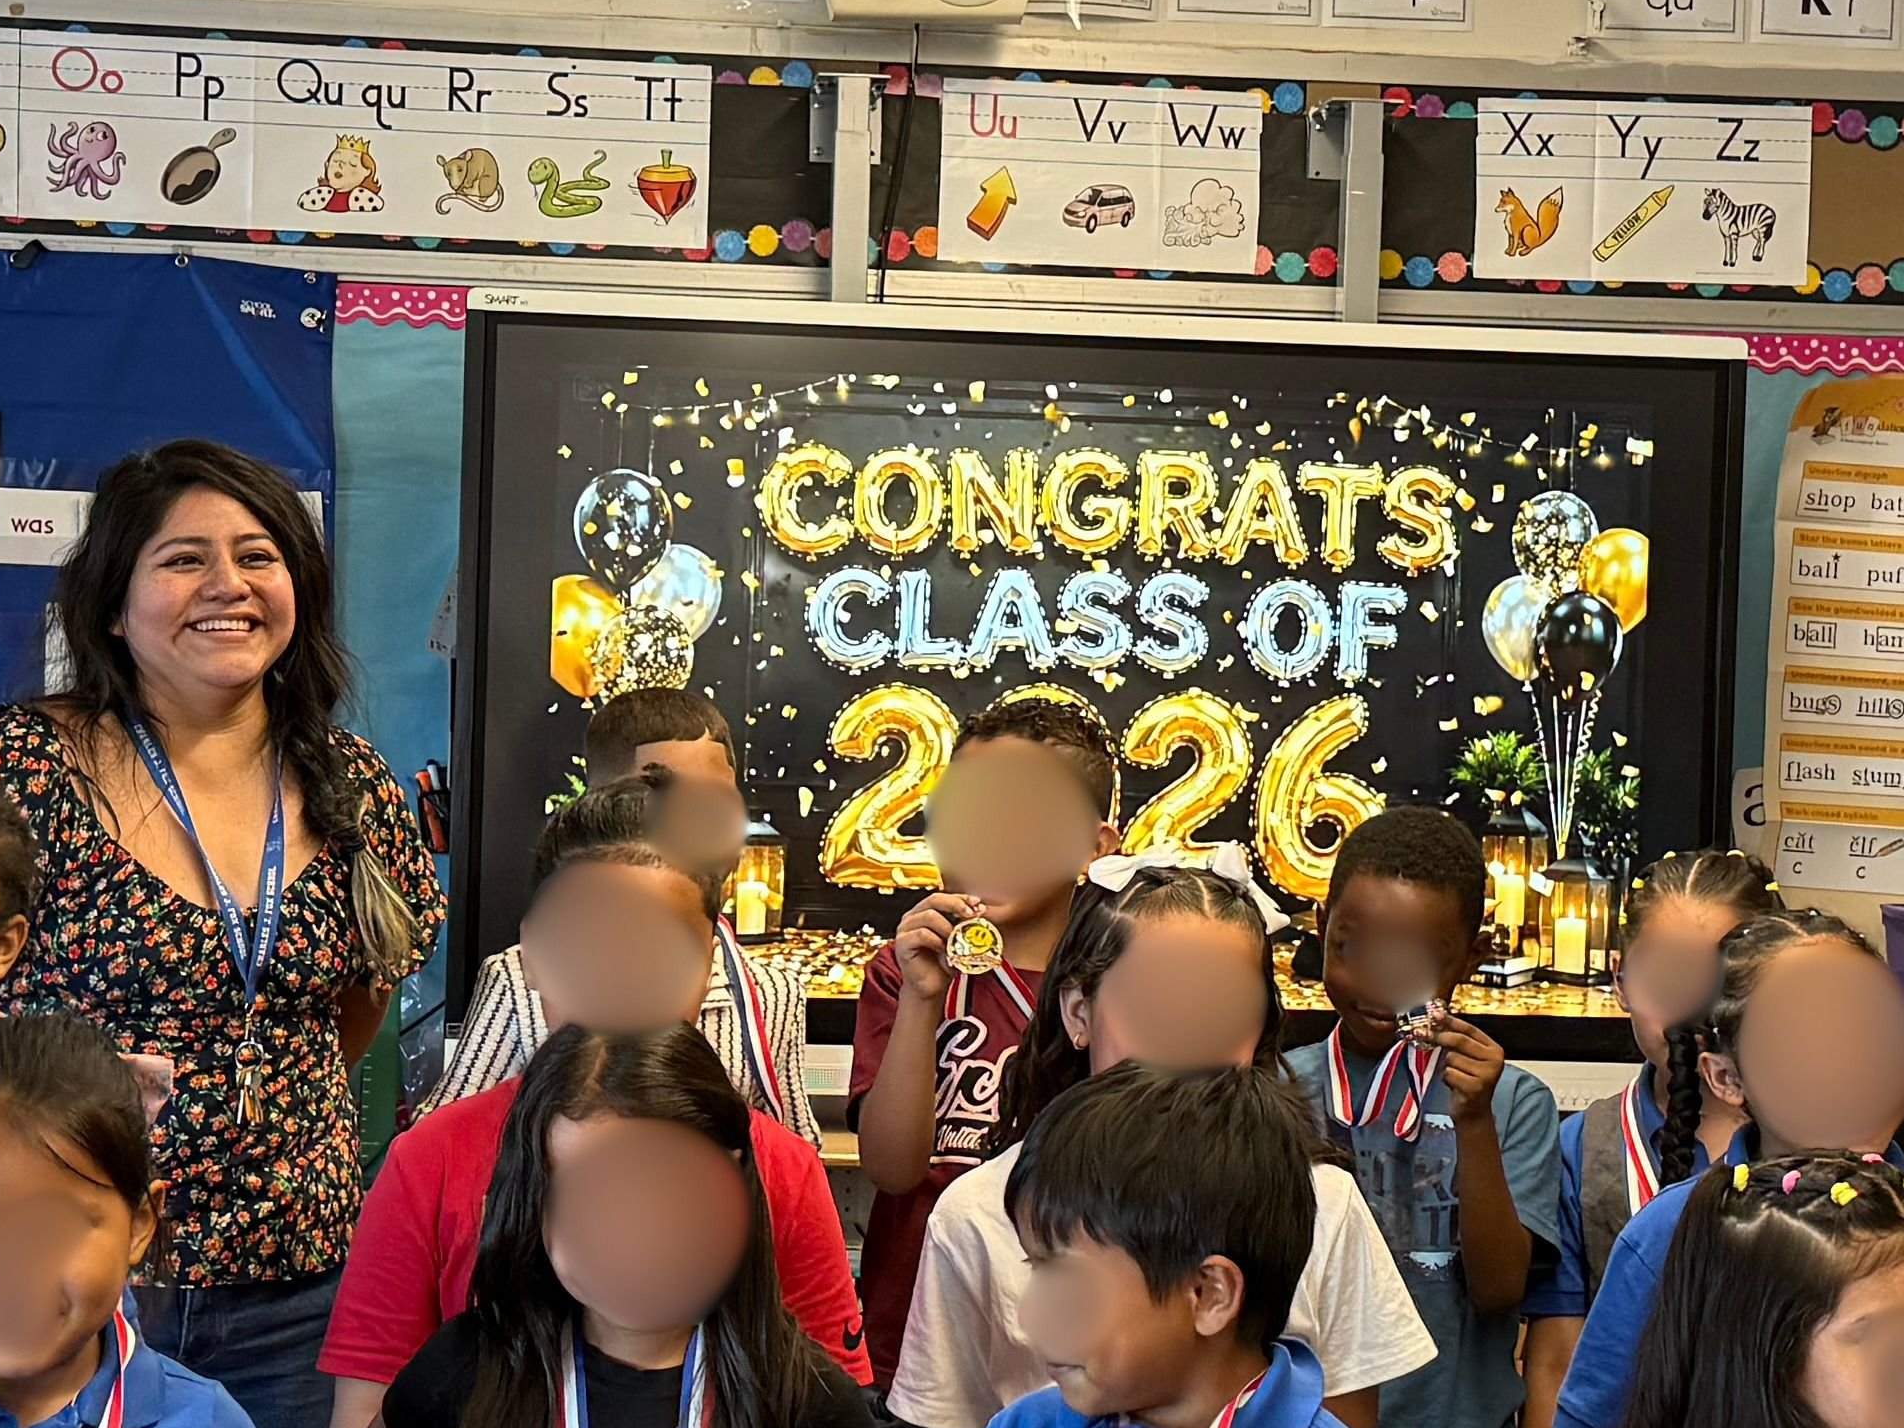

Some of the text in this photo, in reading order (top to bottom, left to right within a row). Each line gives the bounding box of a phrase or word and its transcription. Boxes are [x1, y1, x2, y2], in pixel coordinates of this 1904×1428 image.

[52, 47, 123, 94] Oo
[176, 52, 224, 102] Pp
[278, 60, 342, 107] Qu
[362, 81, 407, 128] qu
[448, 68, 492, 112] Rr
[547, 77, 588, 117] Ss
[635, 76, 683, 122] Tt
[969, 93, 1246, 149] Uu Vv Ww
[1501, 113, 1760, 178] Xx Yy Zz
[1612, 213, 1640, 243] YELLOW
[484, 294, 519, 305] SMART
[11, 513, 54, 535] was
[756, 442, 1460, 574] CONGRATS
[1806, 490, 1855, 516] shop
[808, 566, 1409, 682] CLASS OF
[818, 682, 1386, 901] 226
[1787, 761, 1835, 781] flash
